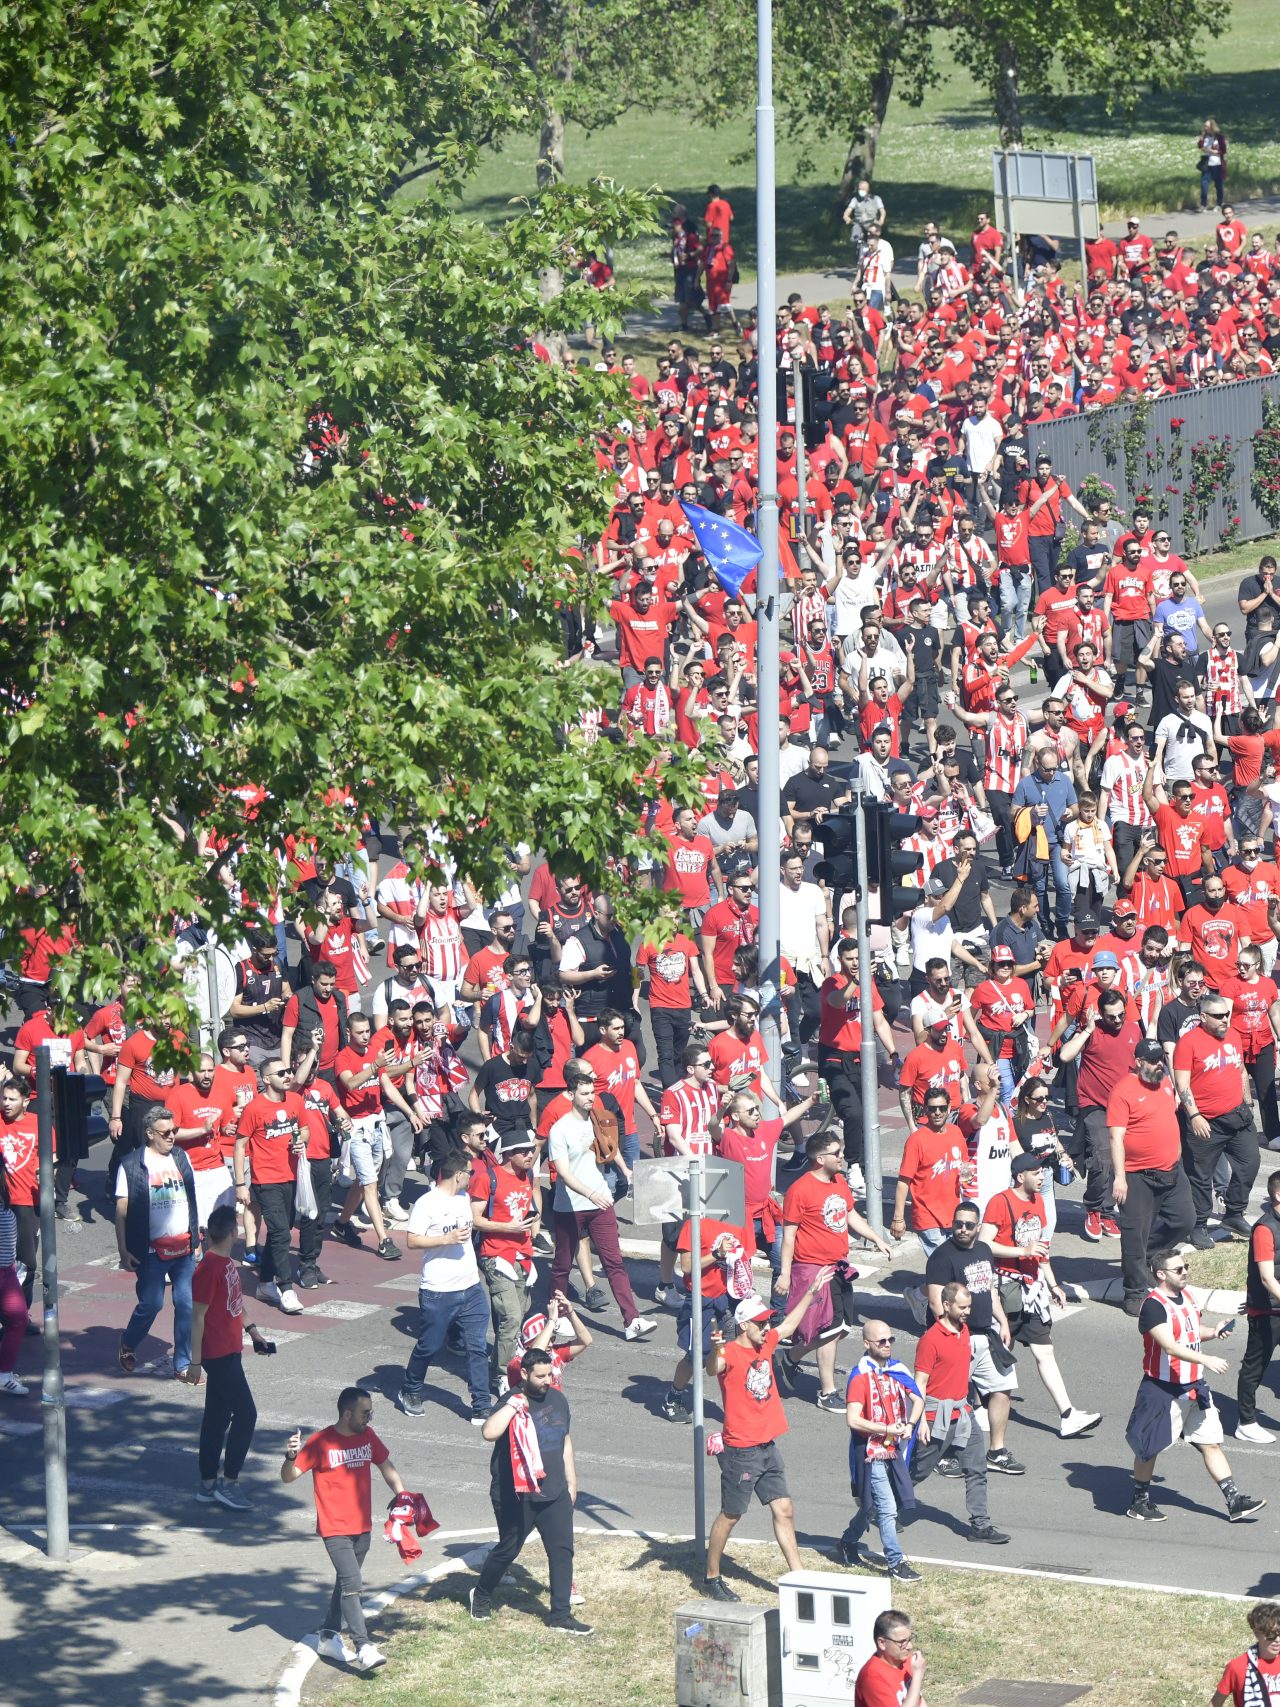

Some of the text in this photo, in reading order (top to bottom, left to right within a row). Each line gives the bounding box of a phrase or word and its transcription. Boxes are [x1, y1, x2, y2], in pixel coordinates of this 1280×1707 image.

[329, 946, 349, 956] adidas
[262, 979, 271, 995] 7
[328, 1442, 373, 1465] OLYMPIACOS
[346, 1460, 366, 1469] PIRAEUS
